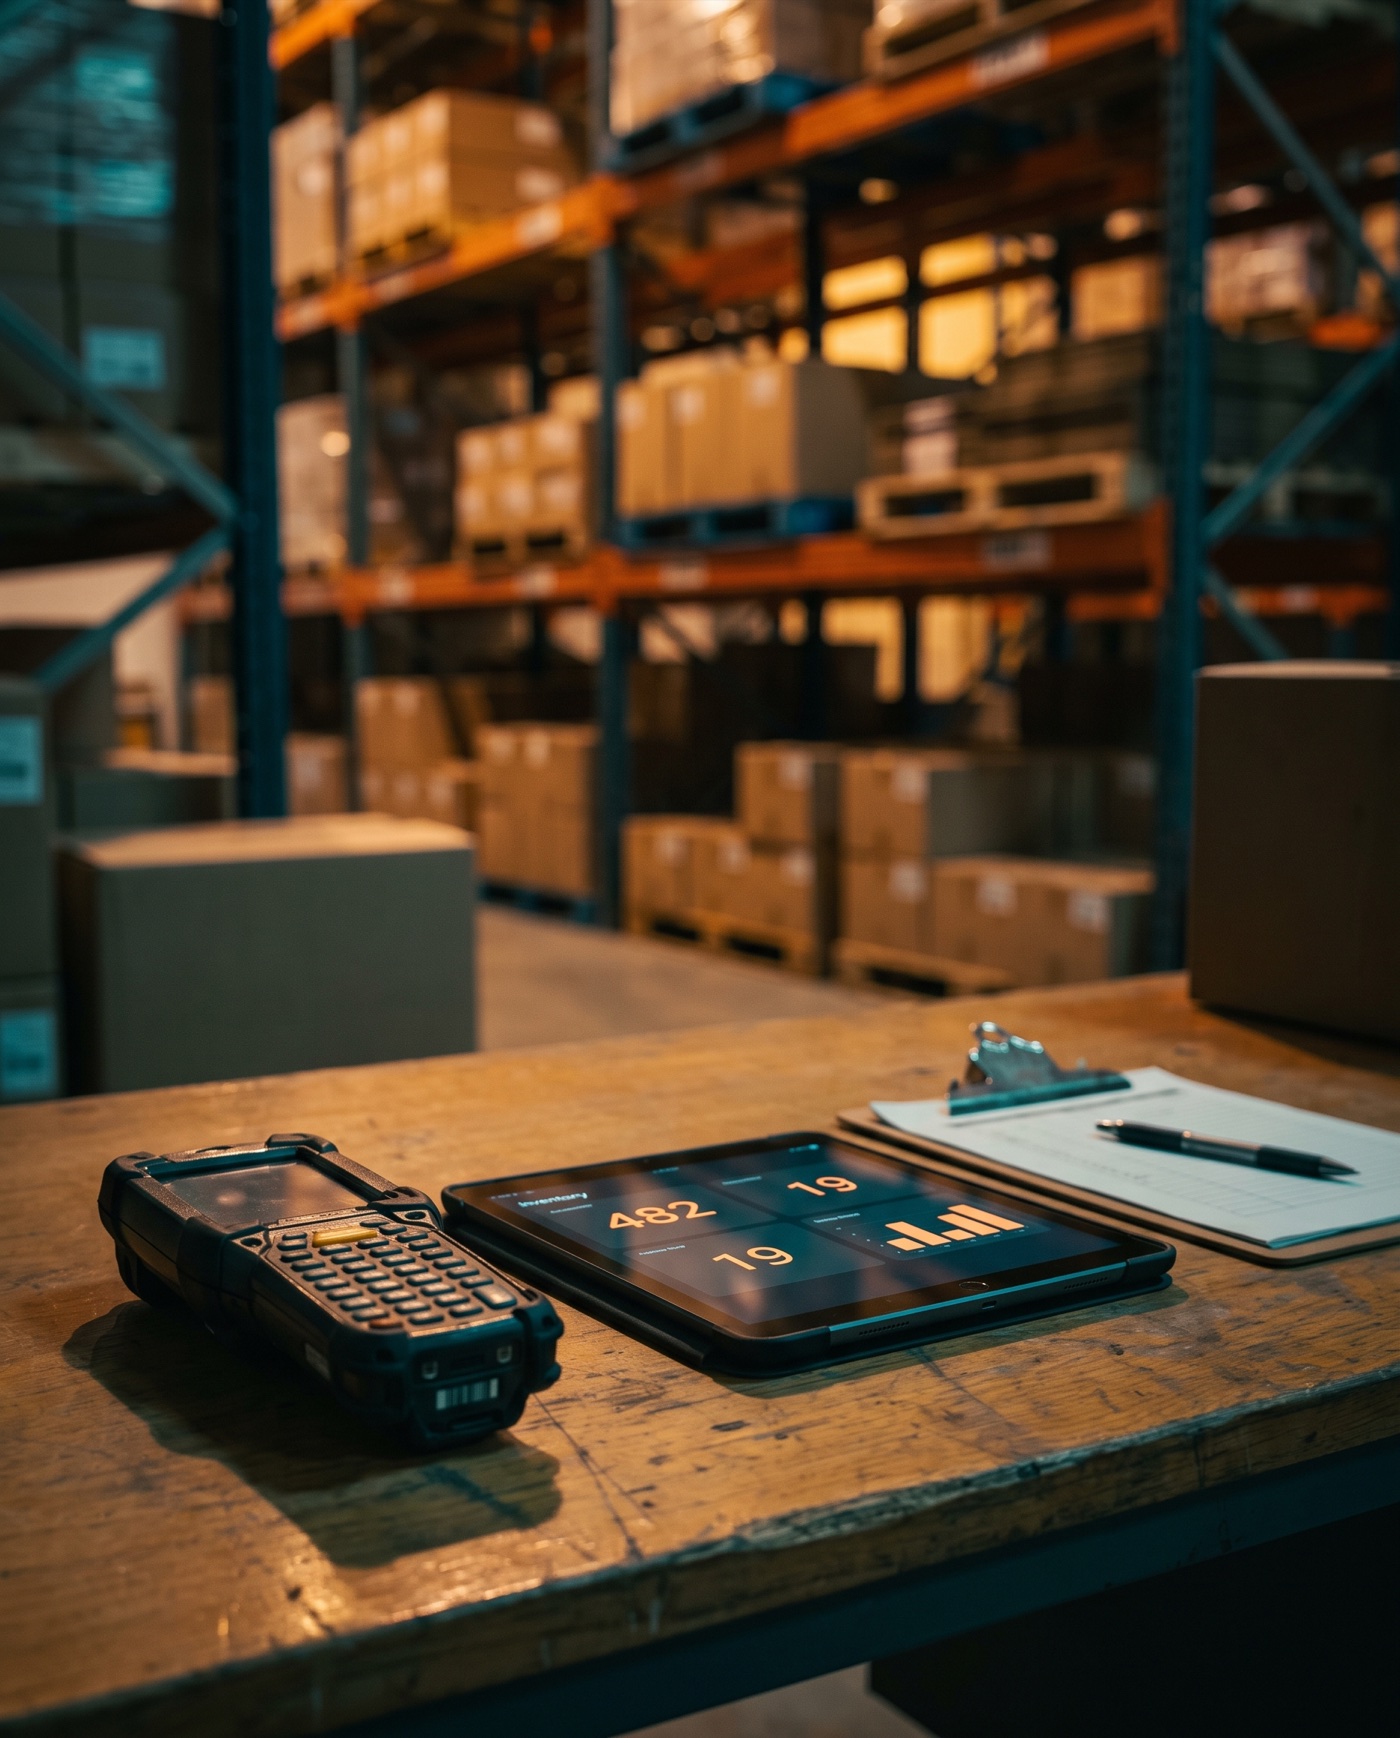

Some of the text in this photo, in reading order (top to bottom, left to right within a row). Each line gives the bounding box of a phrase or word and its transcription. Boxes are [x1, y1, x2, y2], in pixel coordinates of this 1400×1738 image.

[787, 1176, 858, 1196] 19
[518, 1192, 588, 1208] Inventory
[609, 1200, 717, 1229] 482
[712, 1246, 793, 1271] 19
